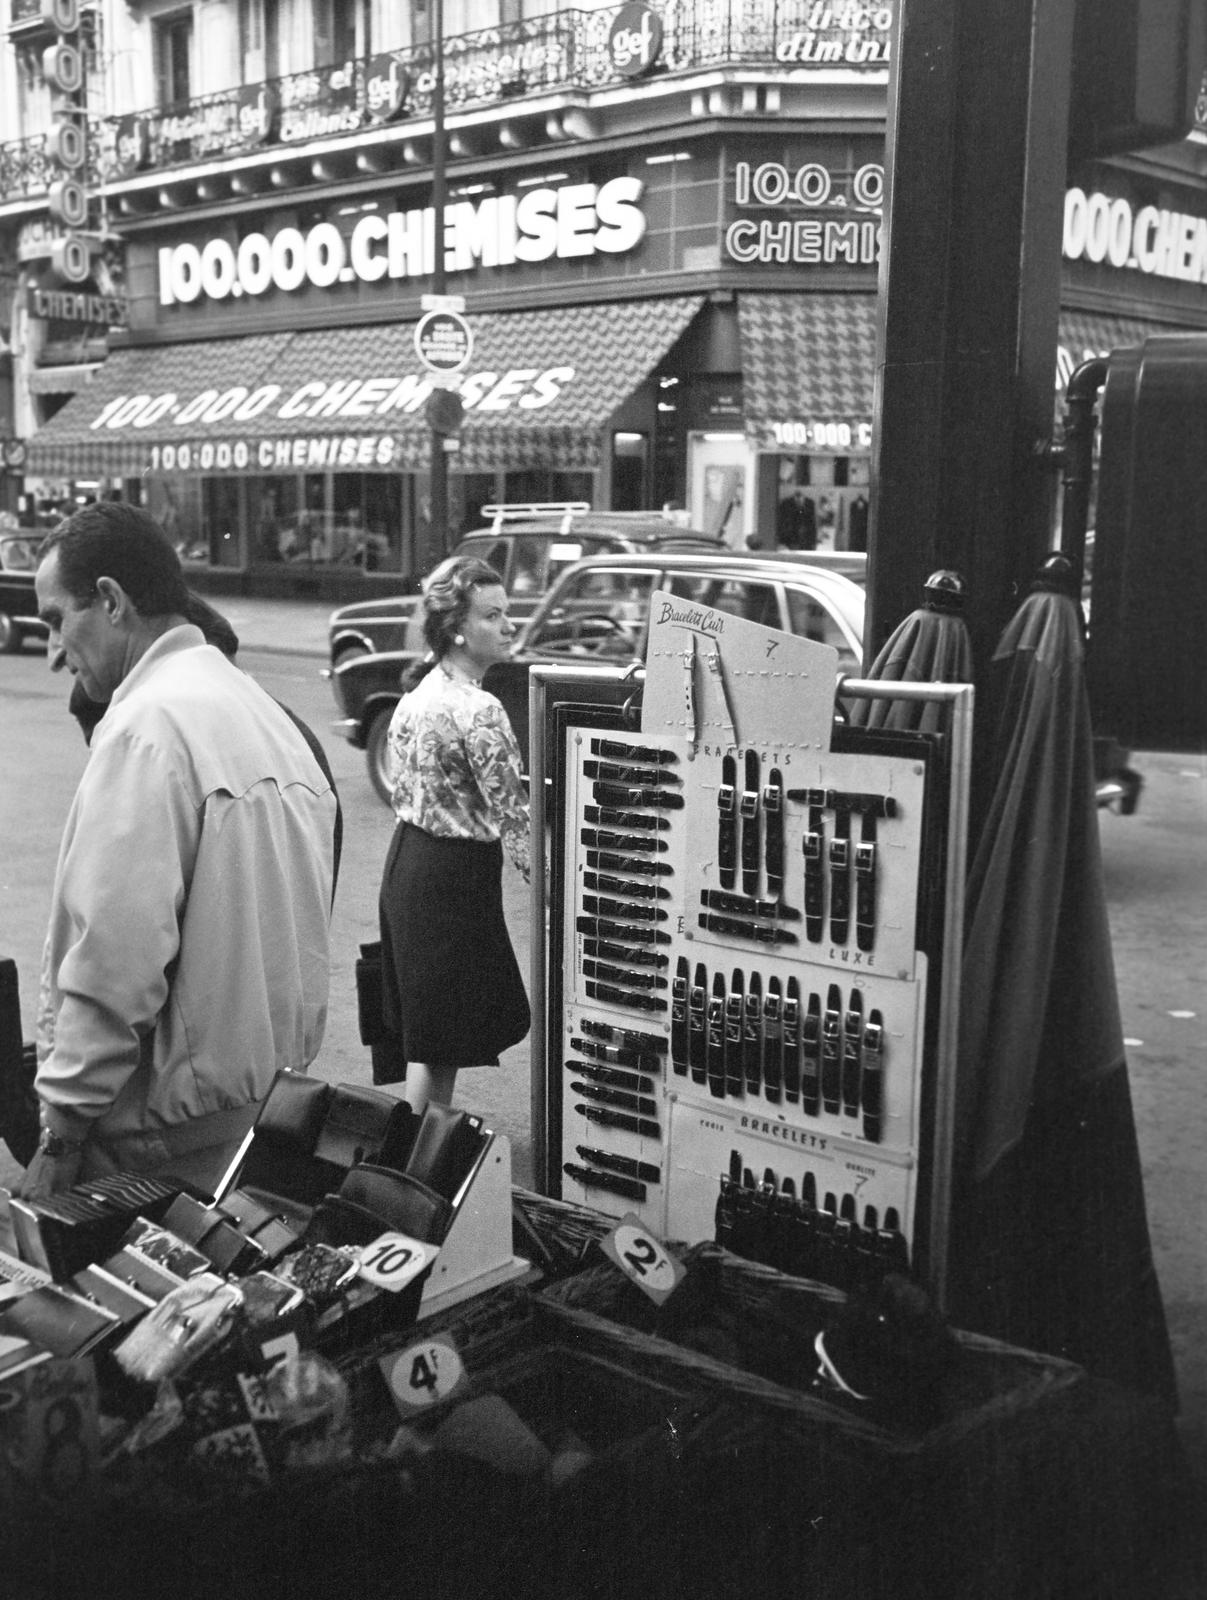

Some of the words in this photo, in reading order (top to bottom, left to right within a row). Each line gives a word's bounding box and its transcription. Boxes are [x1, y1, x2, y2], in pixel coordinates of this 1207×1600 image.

[725, 219, 882, 264] CHEMI
[277, 366, 576, 421] CHEMSES
[258, 435, 394, 468] CHEMISES
[829, 947, 875, 967] LUXE
[740, 1115, 828, 1151] BRACELETS
